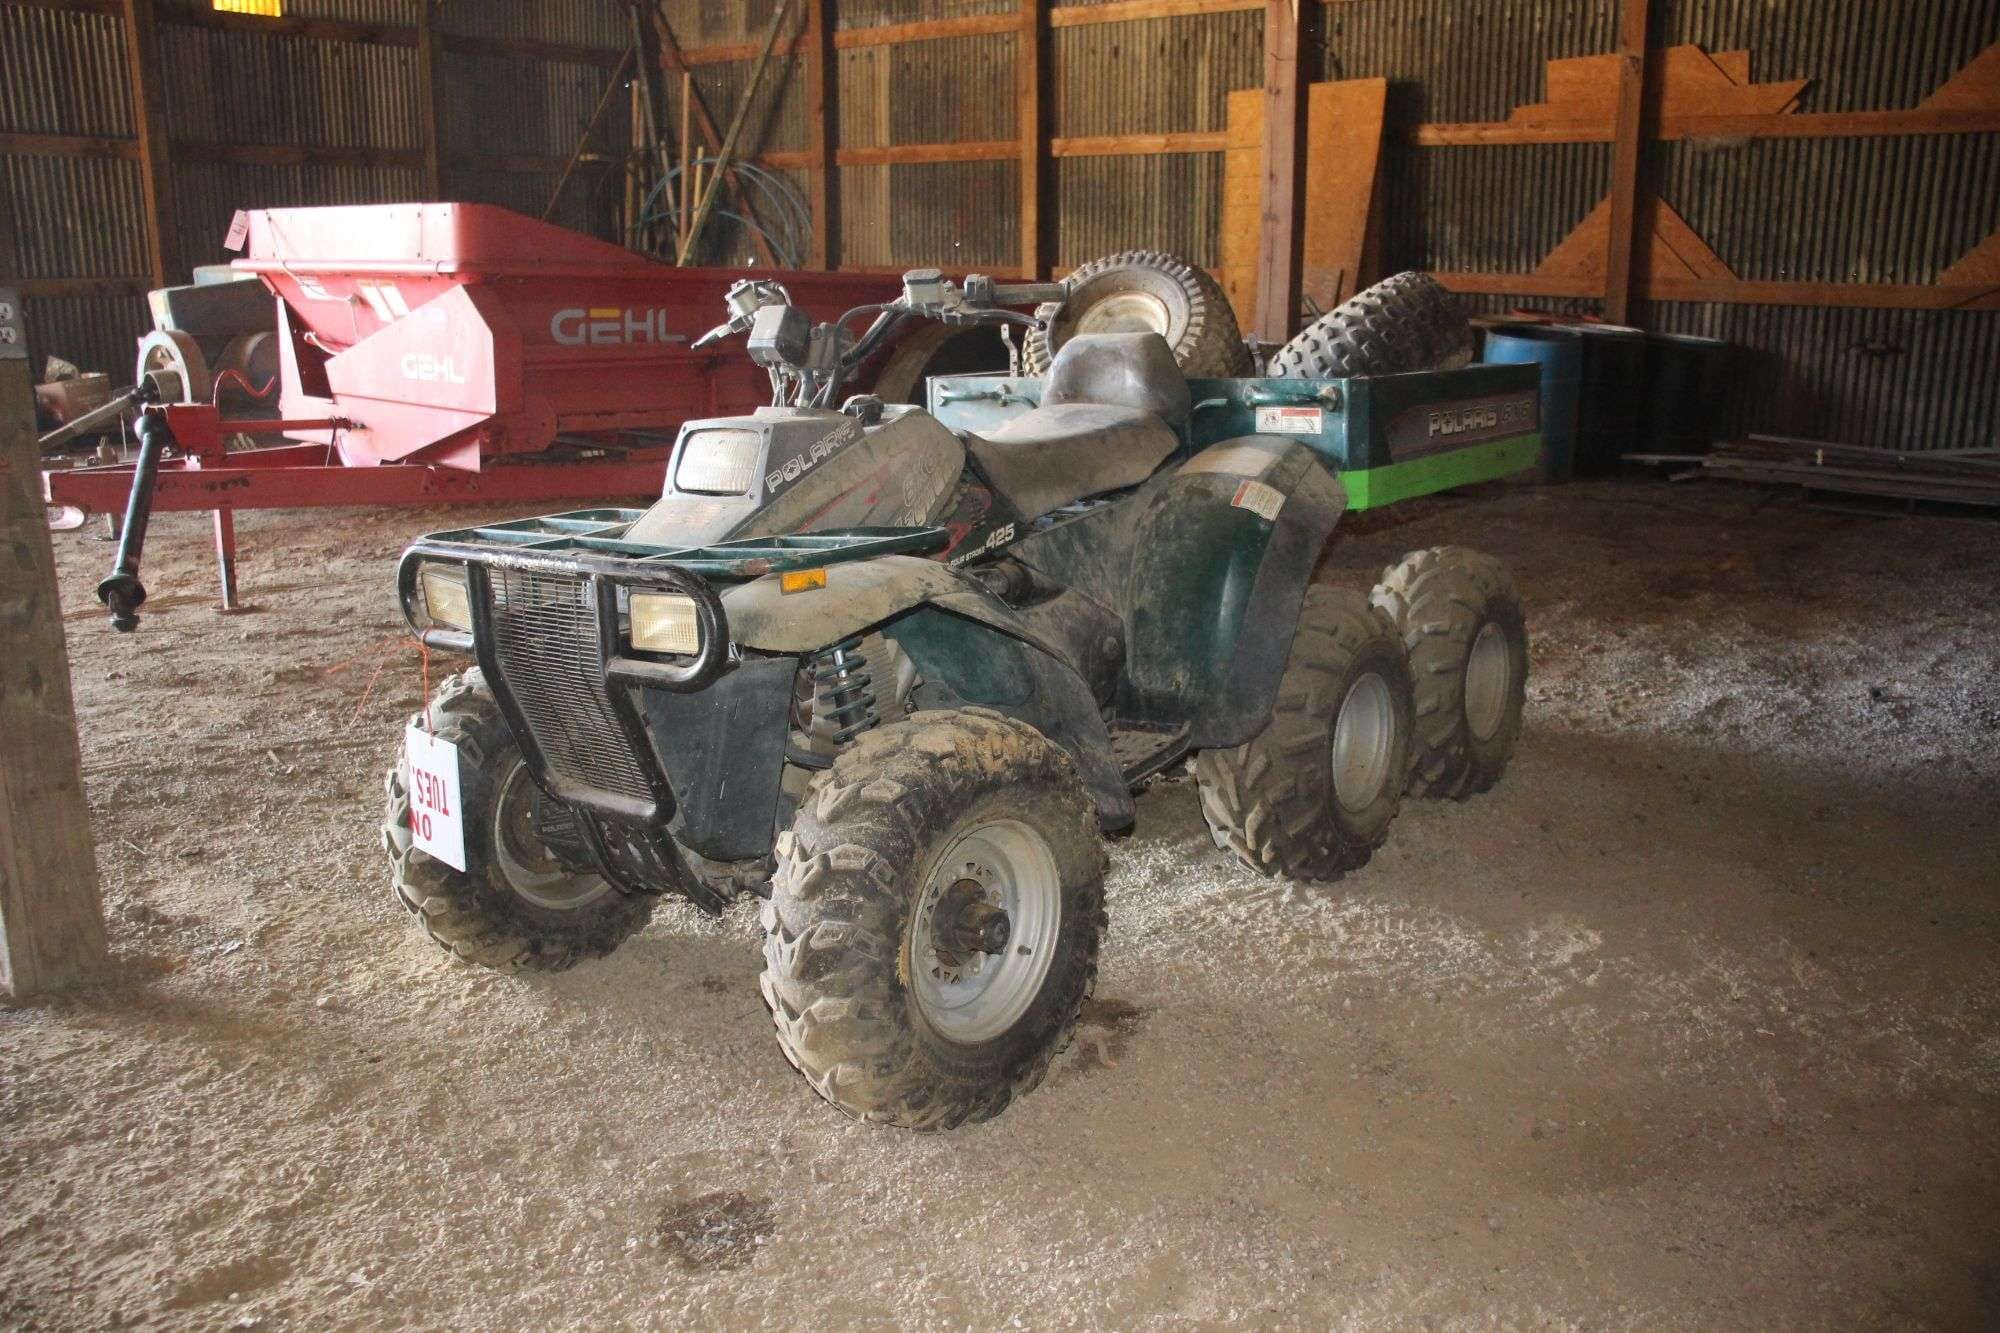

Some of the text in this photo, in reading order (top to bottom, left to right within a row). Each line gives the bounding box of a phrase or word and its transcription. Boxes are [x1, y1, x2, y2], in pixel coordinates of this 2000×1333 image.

[551, 308, 687, 344] GEHL
[400, 352, 465, 384] GEHL
[1427, 404, 1497, 437] POLARIS
[765, 421, 856, 494] POLARIS
[986, 522, 1014, 548] 425
[412, 766, 450, 817] TUES.
[408, 807, 433, 842] ON
